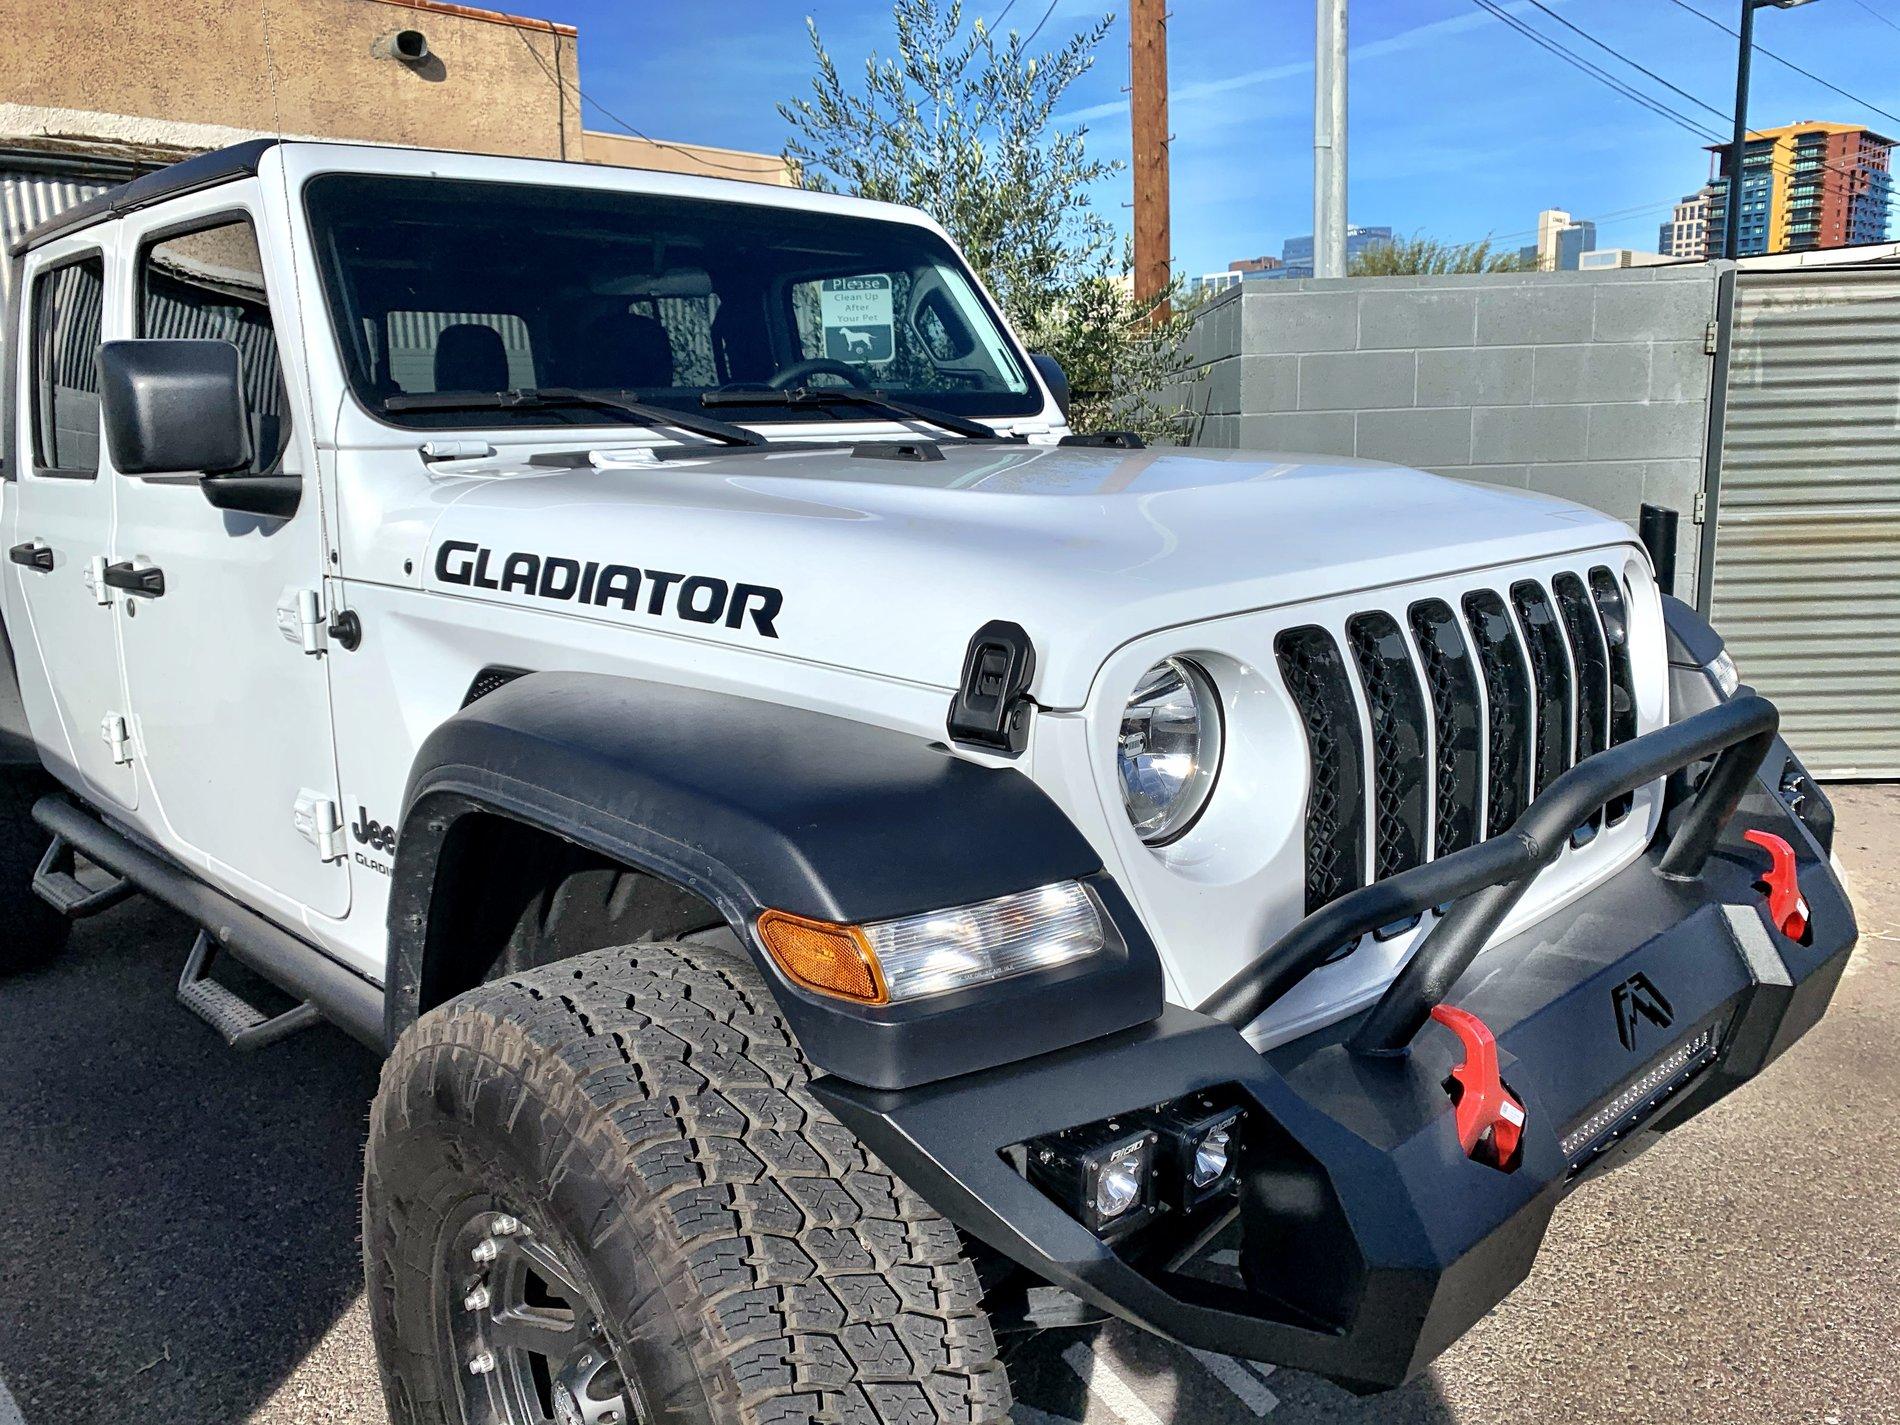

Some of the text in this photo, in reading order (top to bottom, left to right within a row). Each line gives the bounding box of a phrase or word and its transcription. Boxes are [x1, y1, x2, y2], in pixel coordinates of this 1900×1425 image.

[833, 279, 880, 290] Please
[834, 292, 879, 302] Clean Up
[845, 304, 870, 312] After
[837, 315, 860, 323] Your
[434, 540, 784, 639] GLADIATOR
[351, 805, 397, 857] Jee
[355, 852, 393, 877] GLADI
[1110, 1139, 1144, 1161] RIGID
